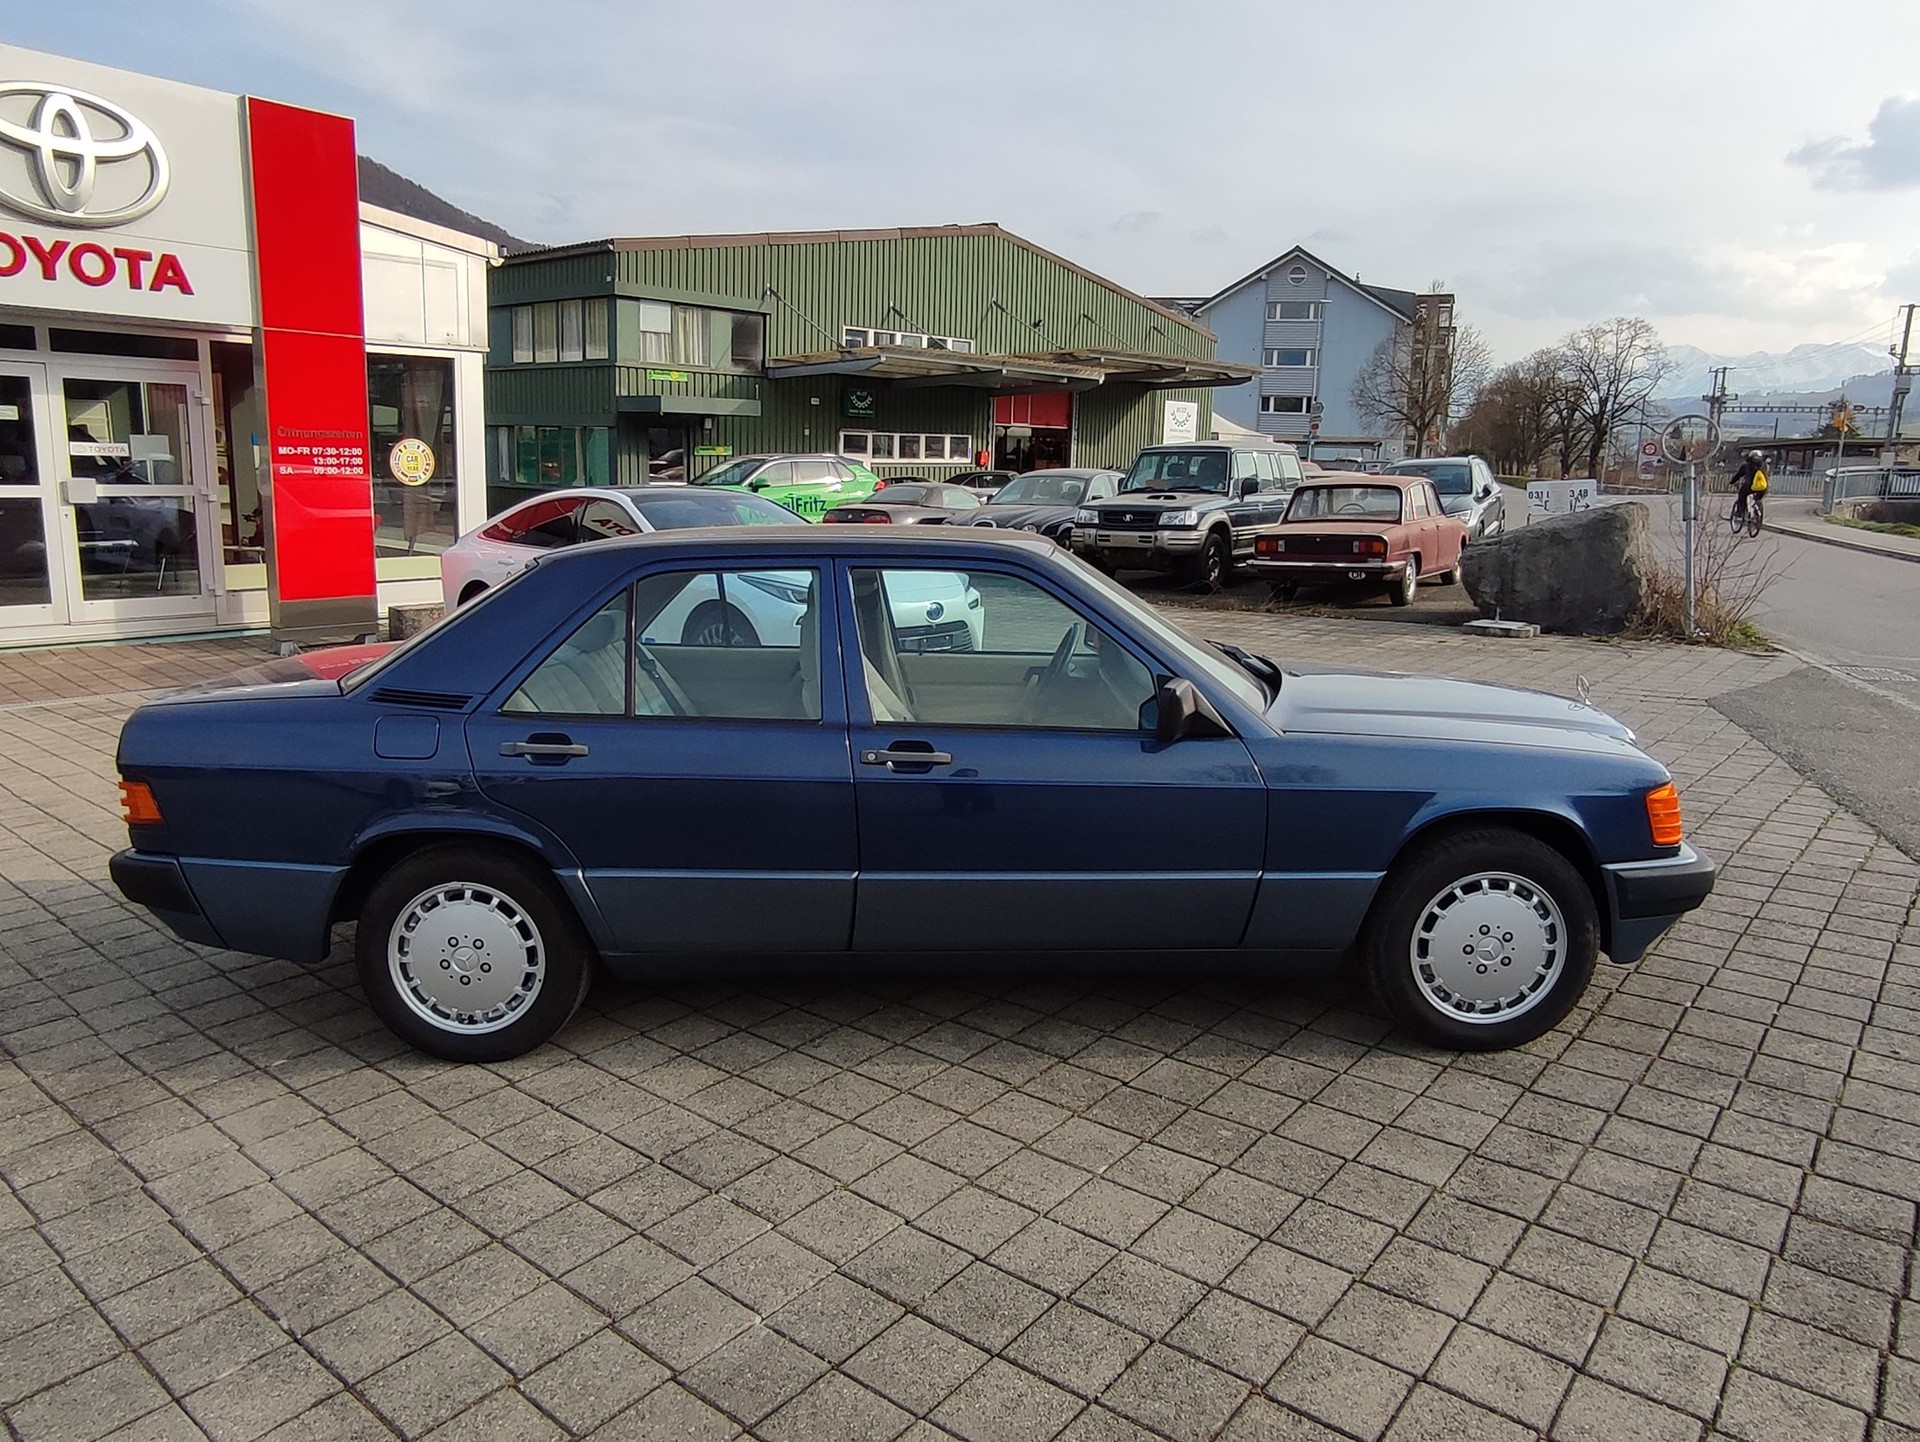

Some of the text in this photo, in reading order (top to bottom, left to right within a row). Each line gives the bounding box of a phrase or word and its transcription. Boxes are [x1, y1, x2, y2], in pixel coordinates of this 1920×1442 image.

[278, 447, 362, 456] MO-FR 07:30-12:00
[313, 457, 363, 465] 13:00-17:00
[279, 466, 364, 475] SA 09:00-12:00
